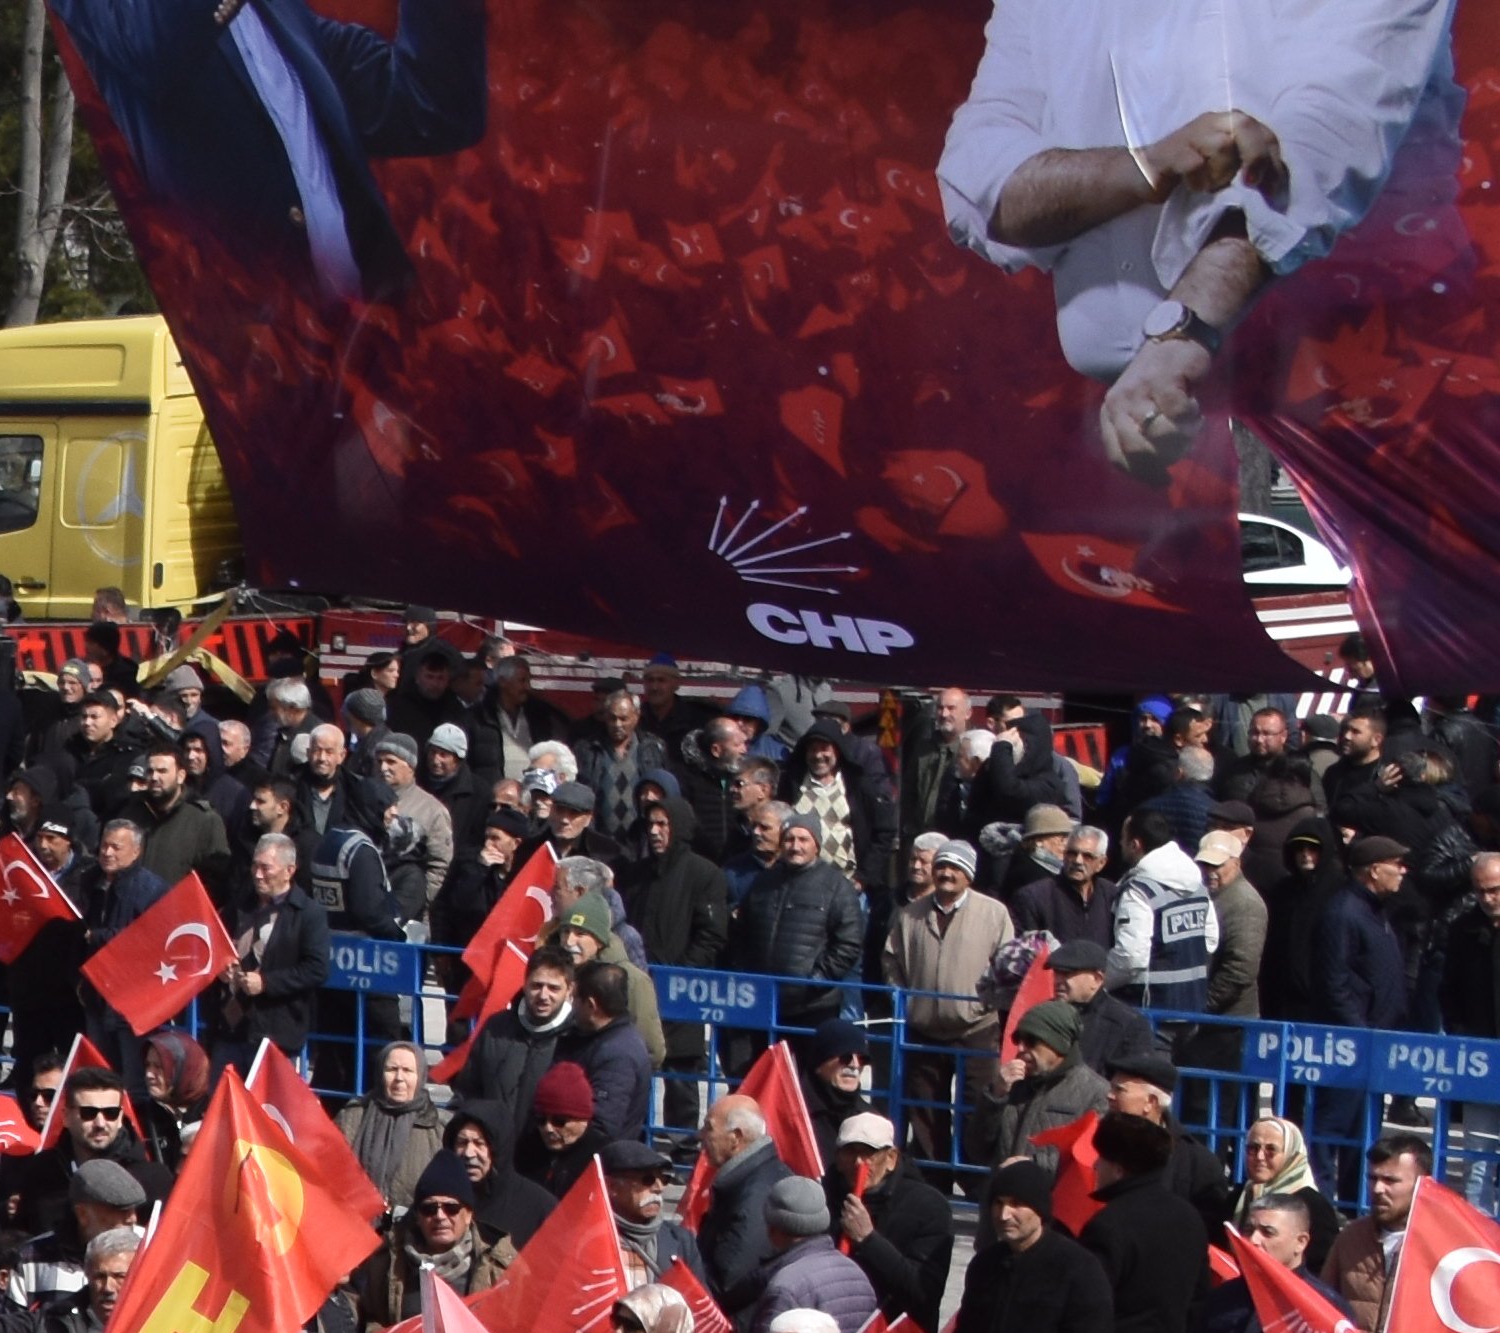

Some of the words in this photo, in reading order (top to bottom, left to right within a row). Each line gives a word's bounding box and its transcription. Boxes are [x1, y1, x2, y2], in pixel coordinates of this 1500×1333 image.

[746, 602, 915, 656] CHP
[347, 974, 370, 989] 70
[668, 976, 756, 1009] POLİS
[700, 1006, 724, 1023] 70
[1257, 1032, 1357, 1067] POLİS
[1388, 1042, 1489, 1077] POLİS
[1292, 1065, 1321, 1083] 70
[1422, 1076, 1452, 1094] 70
